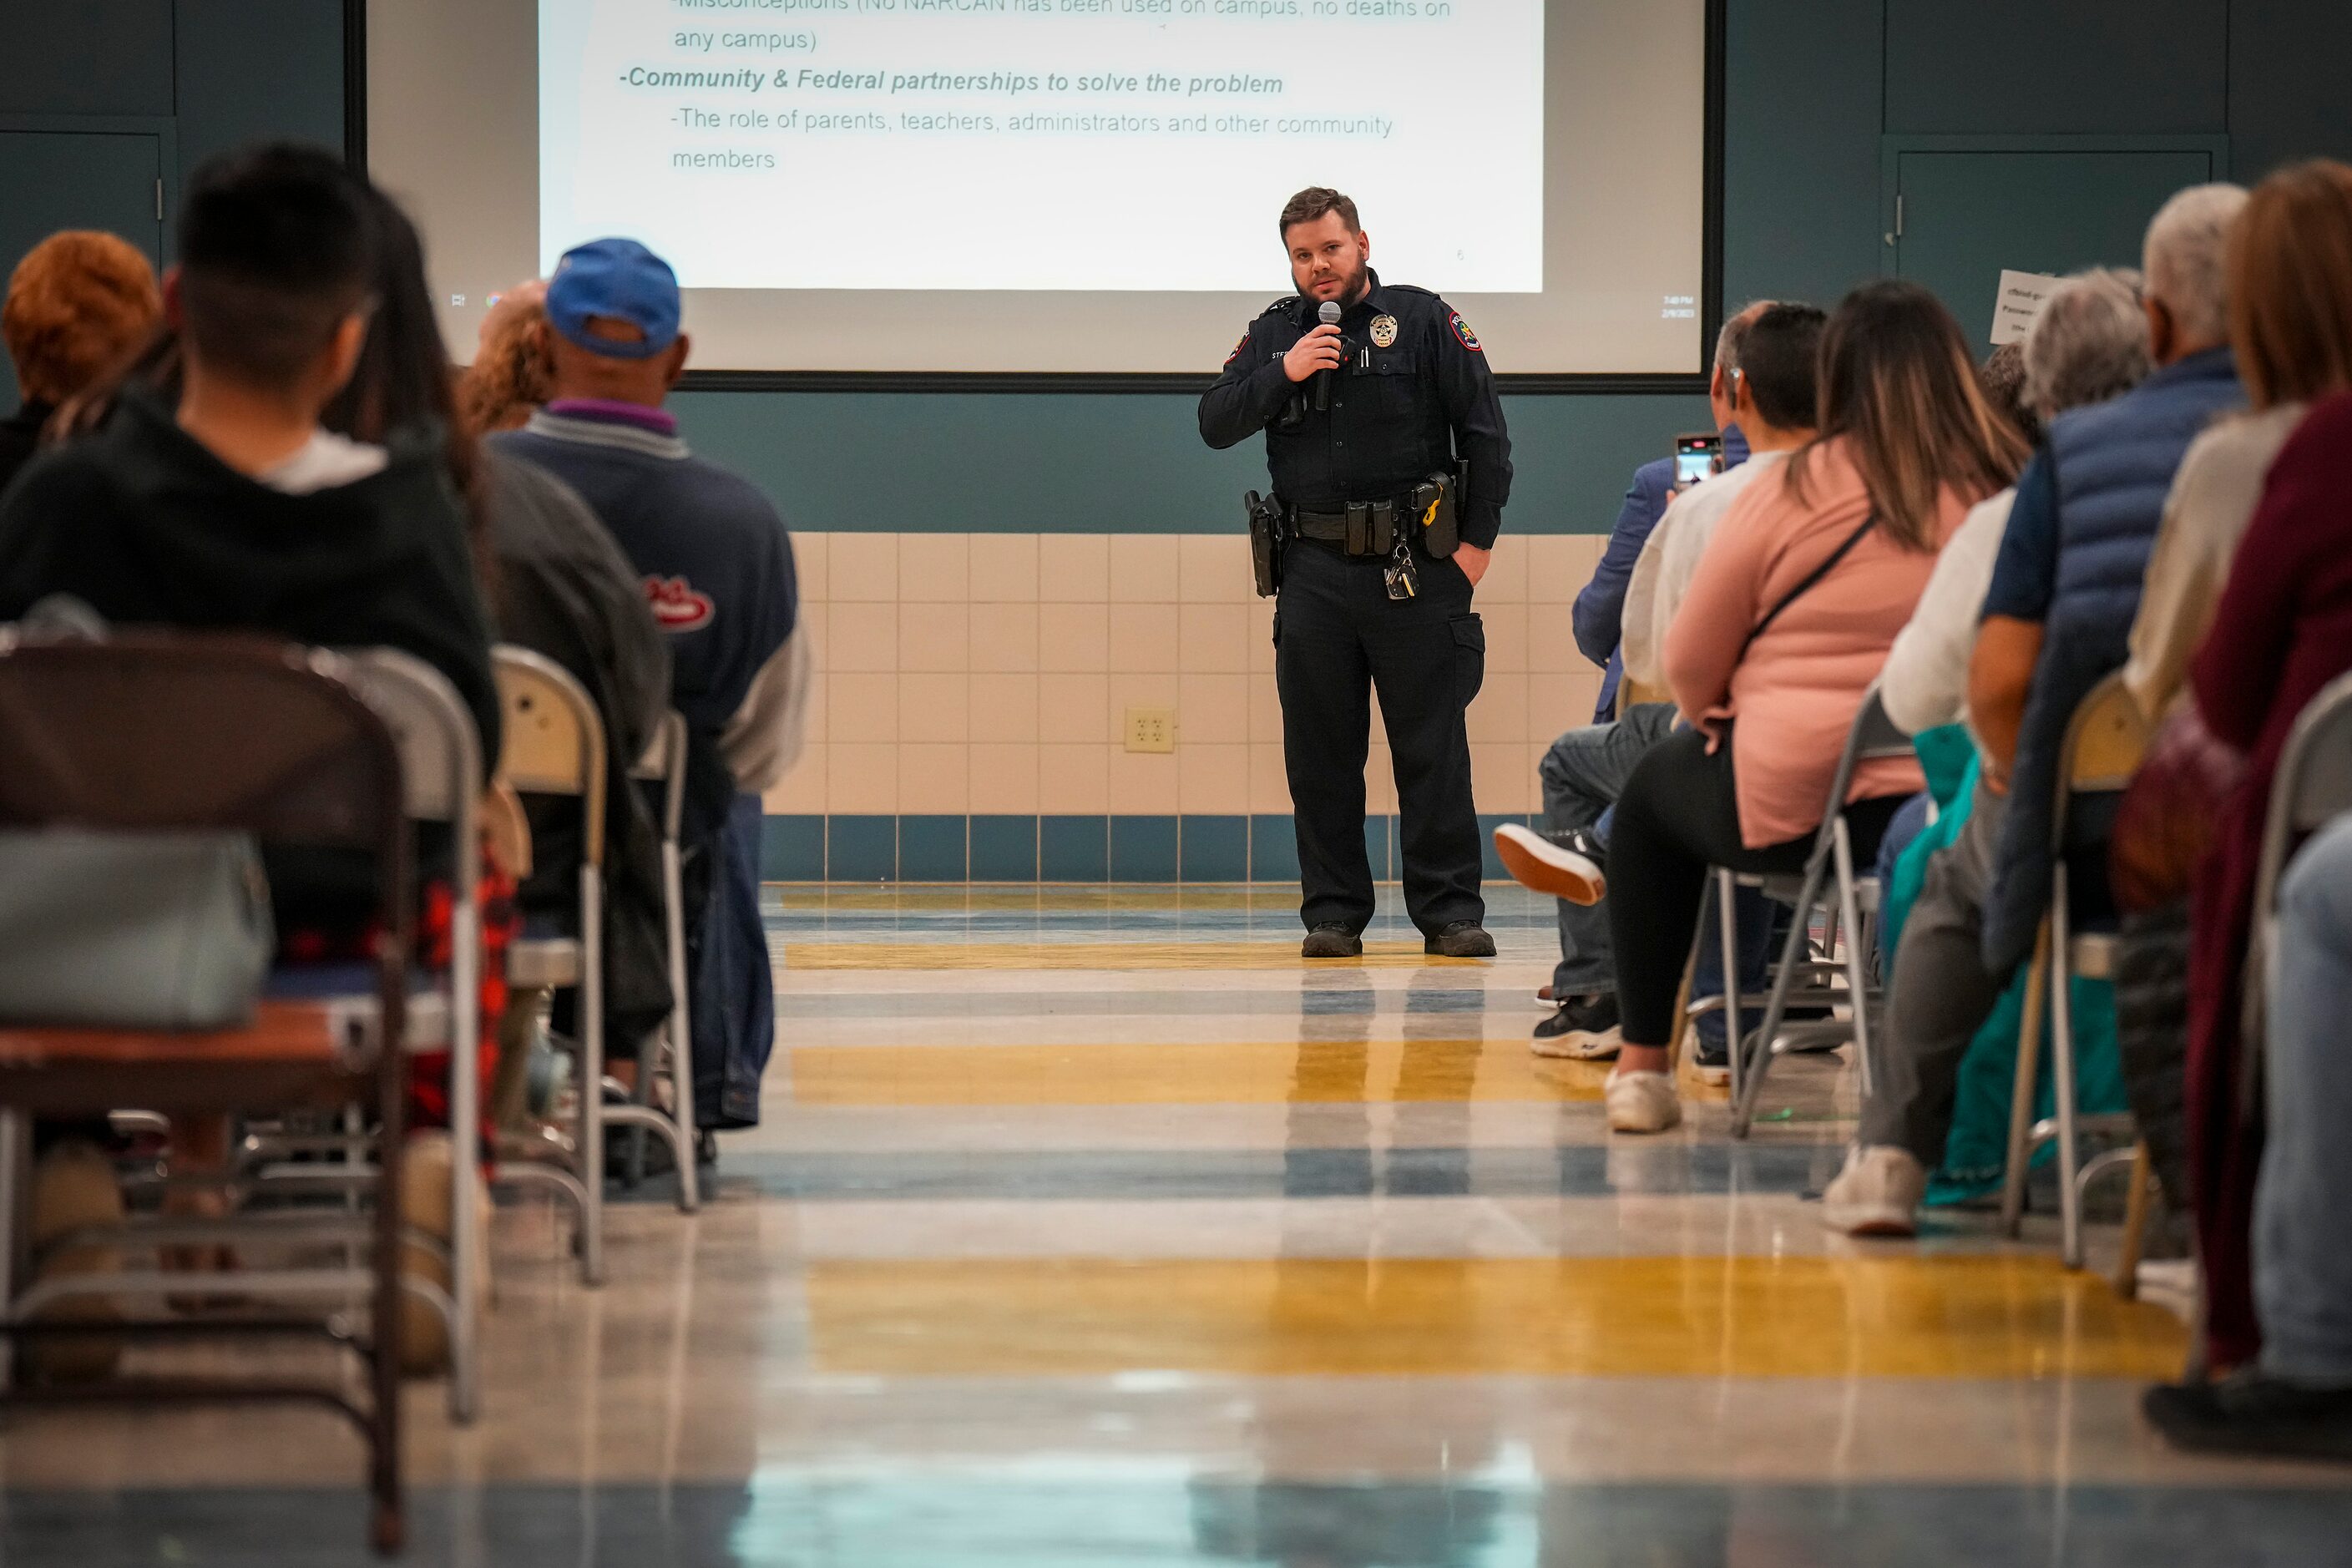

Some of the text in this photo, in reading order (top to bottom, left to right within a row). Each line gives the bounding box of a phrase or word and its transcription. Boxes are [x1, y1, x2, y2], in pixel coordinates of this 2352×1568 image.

[857, 0, 895, 13] (No
[904, 0, 1005, 11] NARCAN
[1014, 0, 1051, 12] has
[1060, 0, 1113, 13] been
[1121, 0, 1172, 13] used
[1180, 0, 1206, 13] on
[1214, 0, 1303, 18] campus,
[1313, 1, 1338, 15] no
[1345, 0, 1418, 16] deaths
[1424, 2, 1450, 17] on
[674, 30, 817, 53] any campus)
[620, 66, 1283, 97] -Community & Federal partnerships to solve the problem
[670, 107, 1393, 139] -The role of parents, teachers, administrators and other community
[673, 149, 776, 169] members
